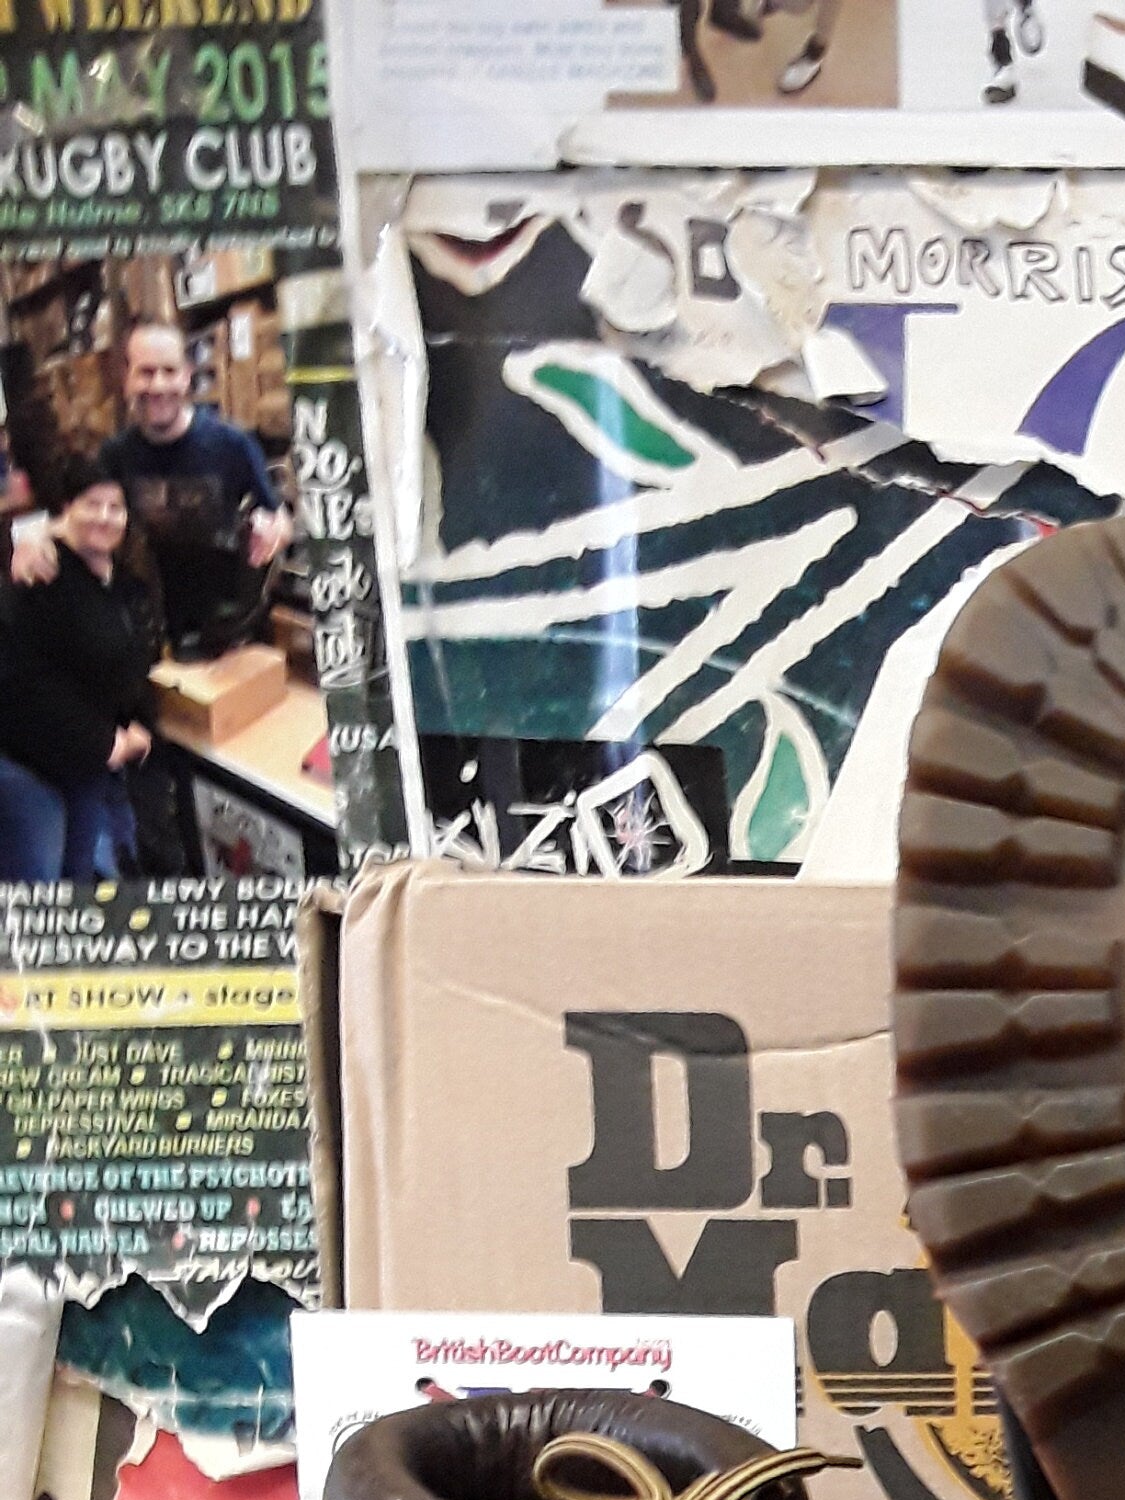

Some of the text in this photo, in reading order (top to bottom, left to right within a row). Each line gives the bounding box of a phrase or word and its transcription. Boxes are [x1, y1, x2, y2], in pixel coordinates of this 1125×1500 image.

[184, 122, 317, 191] CLUB
[173, 904, 229, 931] THE
[166, 932, 209, 960] TO
[214, 931, 272, 960] THE
[564, 1011, 852, 1210] Dr.
